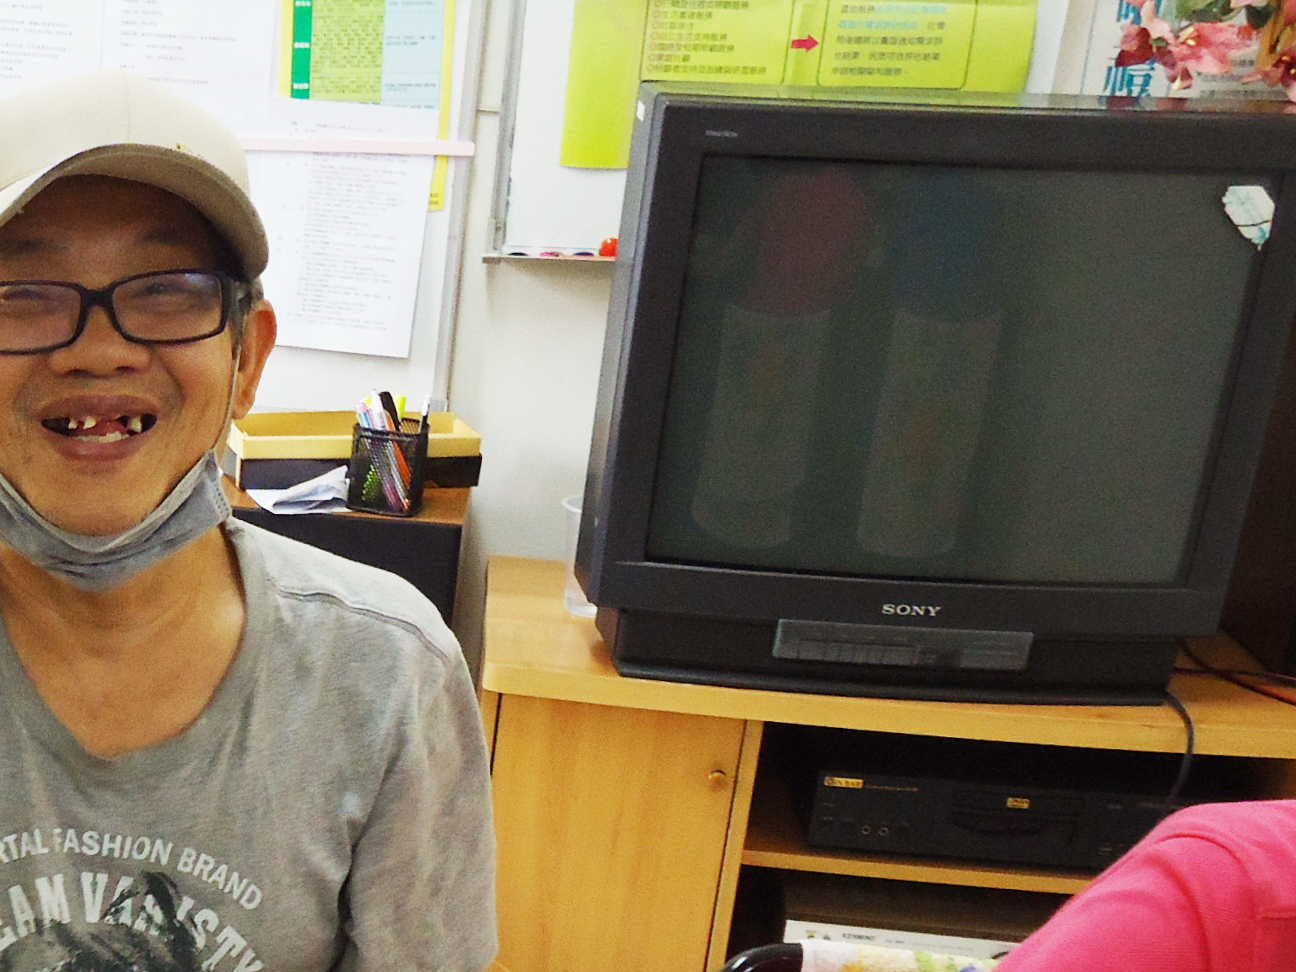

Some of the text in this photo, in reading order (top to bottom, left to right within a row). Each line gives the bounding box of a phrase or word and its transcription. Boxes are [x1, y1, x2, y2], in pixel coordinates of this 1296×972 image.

[881, 603, 942, 617] SONY
[53, 828, 173, 866] FASHION
[177, 847, 263, 910] BRAND
